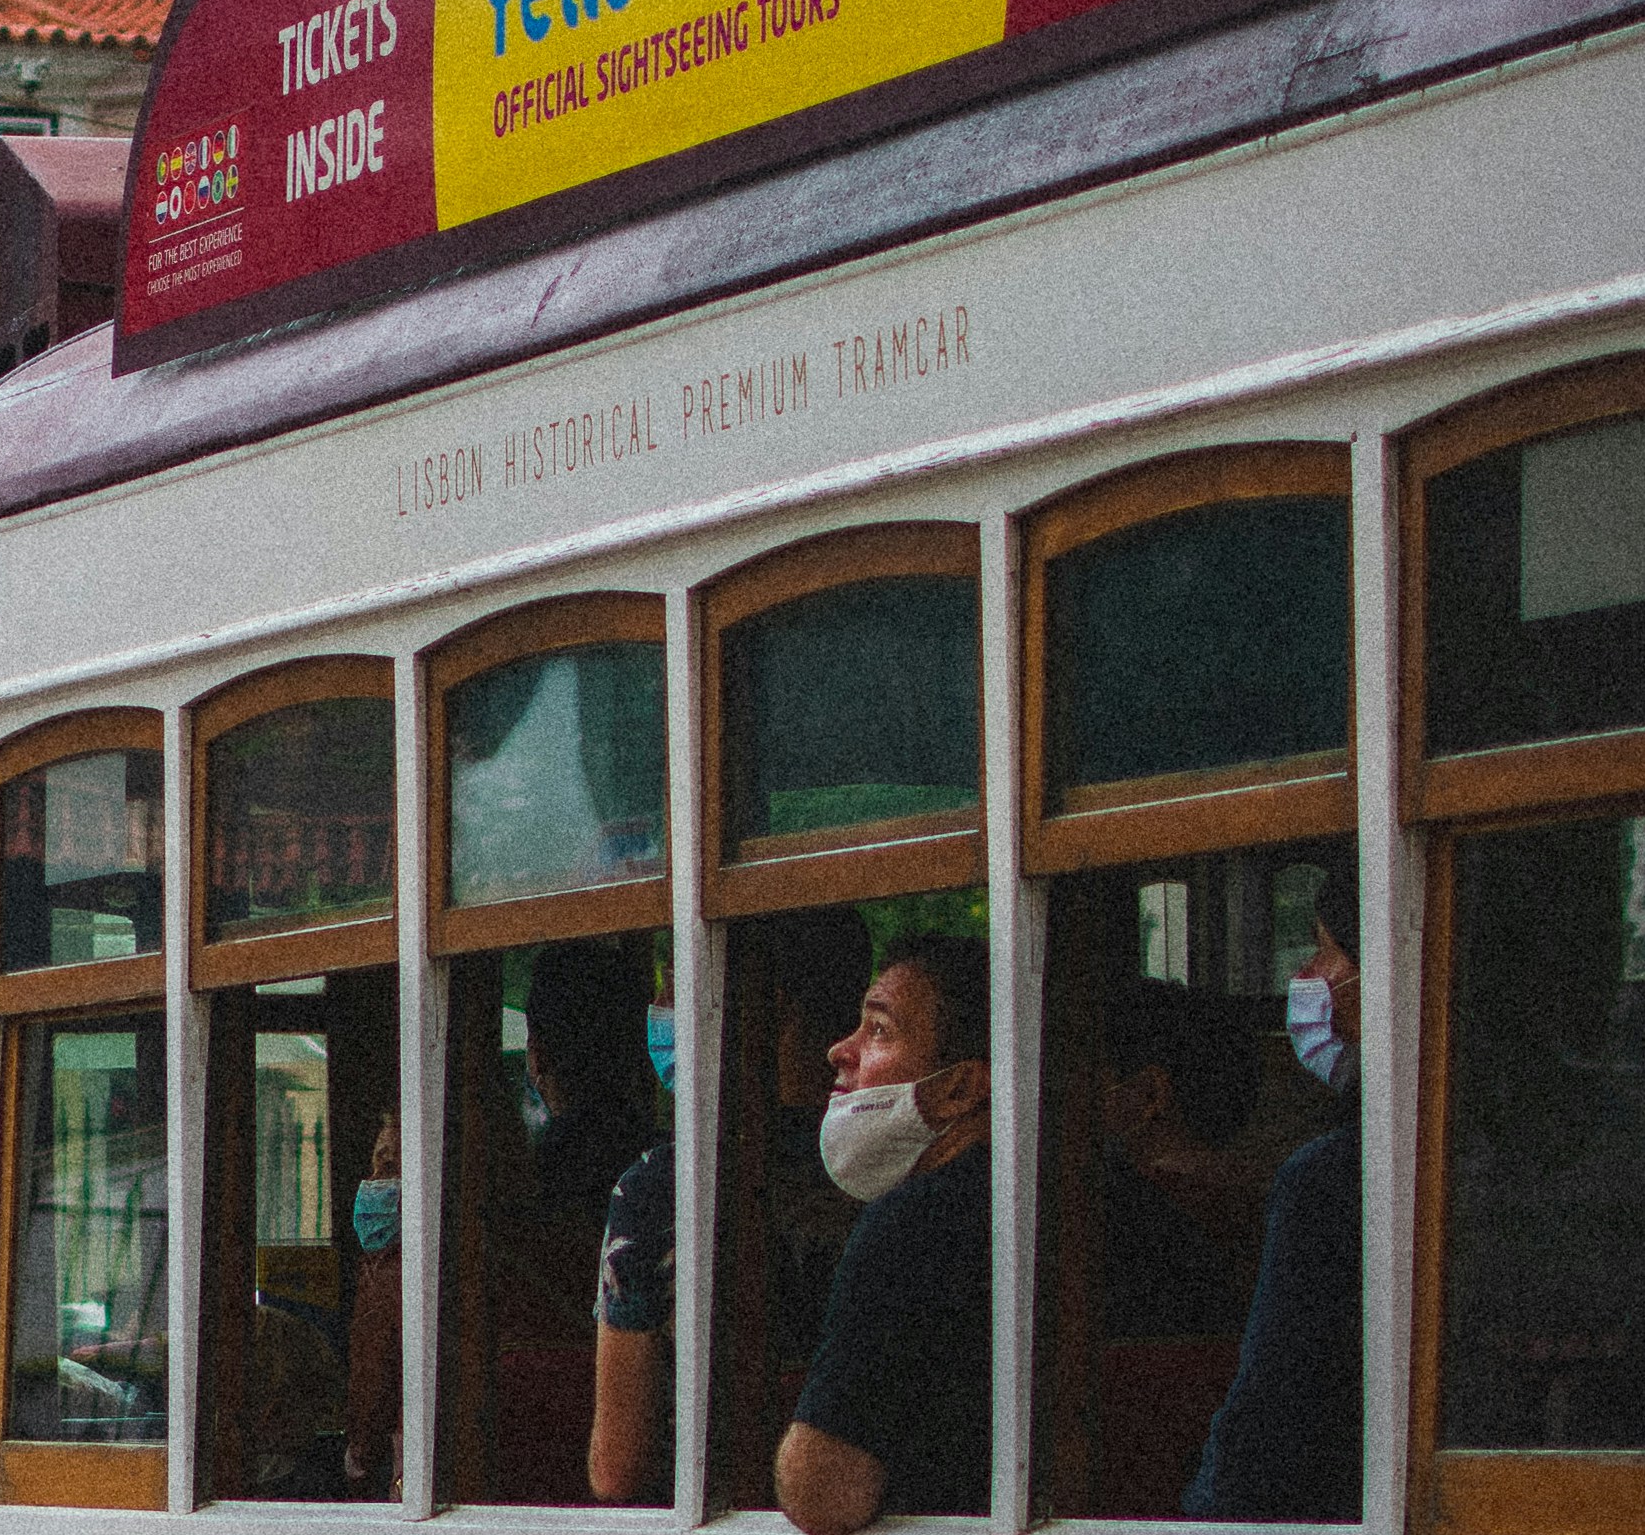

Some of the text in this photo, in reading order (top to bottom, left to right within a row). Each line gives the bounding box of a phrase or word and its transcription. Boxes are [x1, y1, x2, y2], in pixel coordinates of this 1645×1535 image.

[493, 64, 590, 138] OFFICIAL
[596, 1, 750, 102] SIGHTSEEING
[285, 99, 385, 203] INSIDE
[147, 249, 243, 296] CHOOSE THE MOST EXPERIENCED
[149, 222, 243, 272] FOR THE BEST EXPERIENCE
[397, 304, 970, 517] LISBON HISTORICAL PREMIUM TRAMCAR
